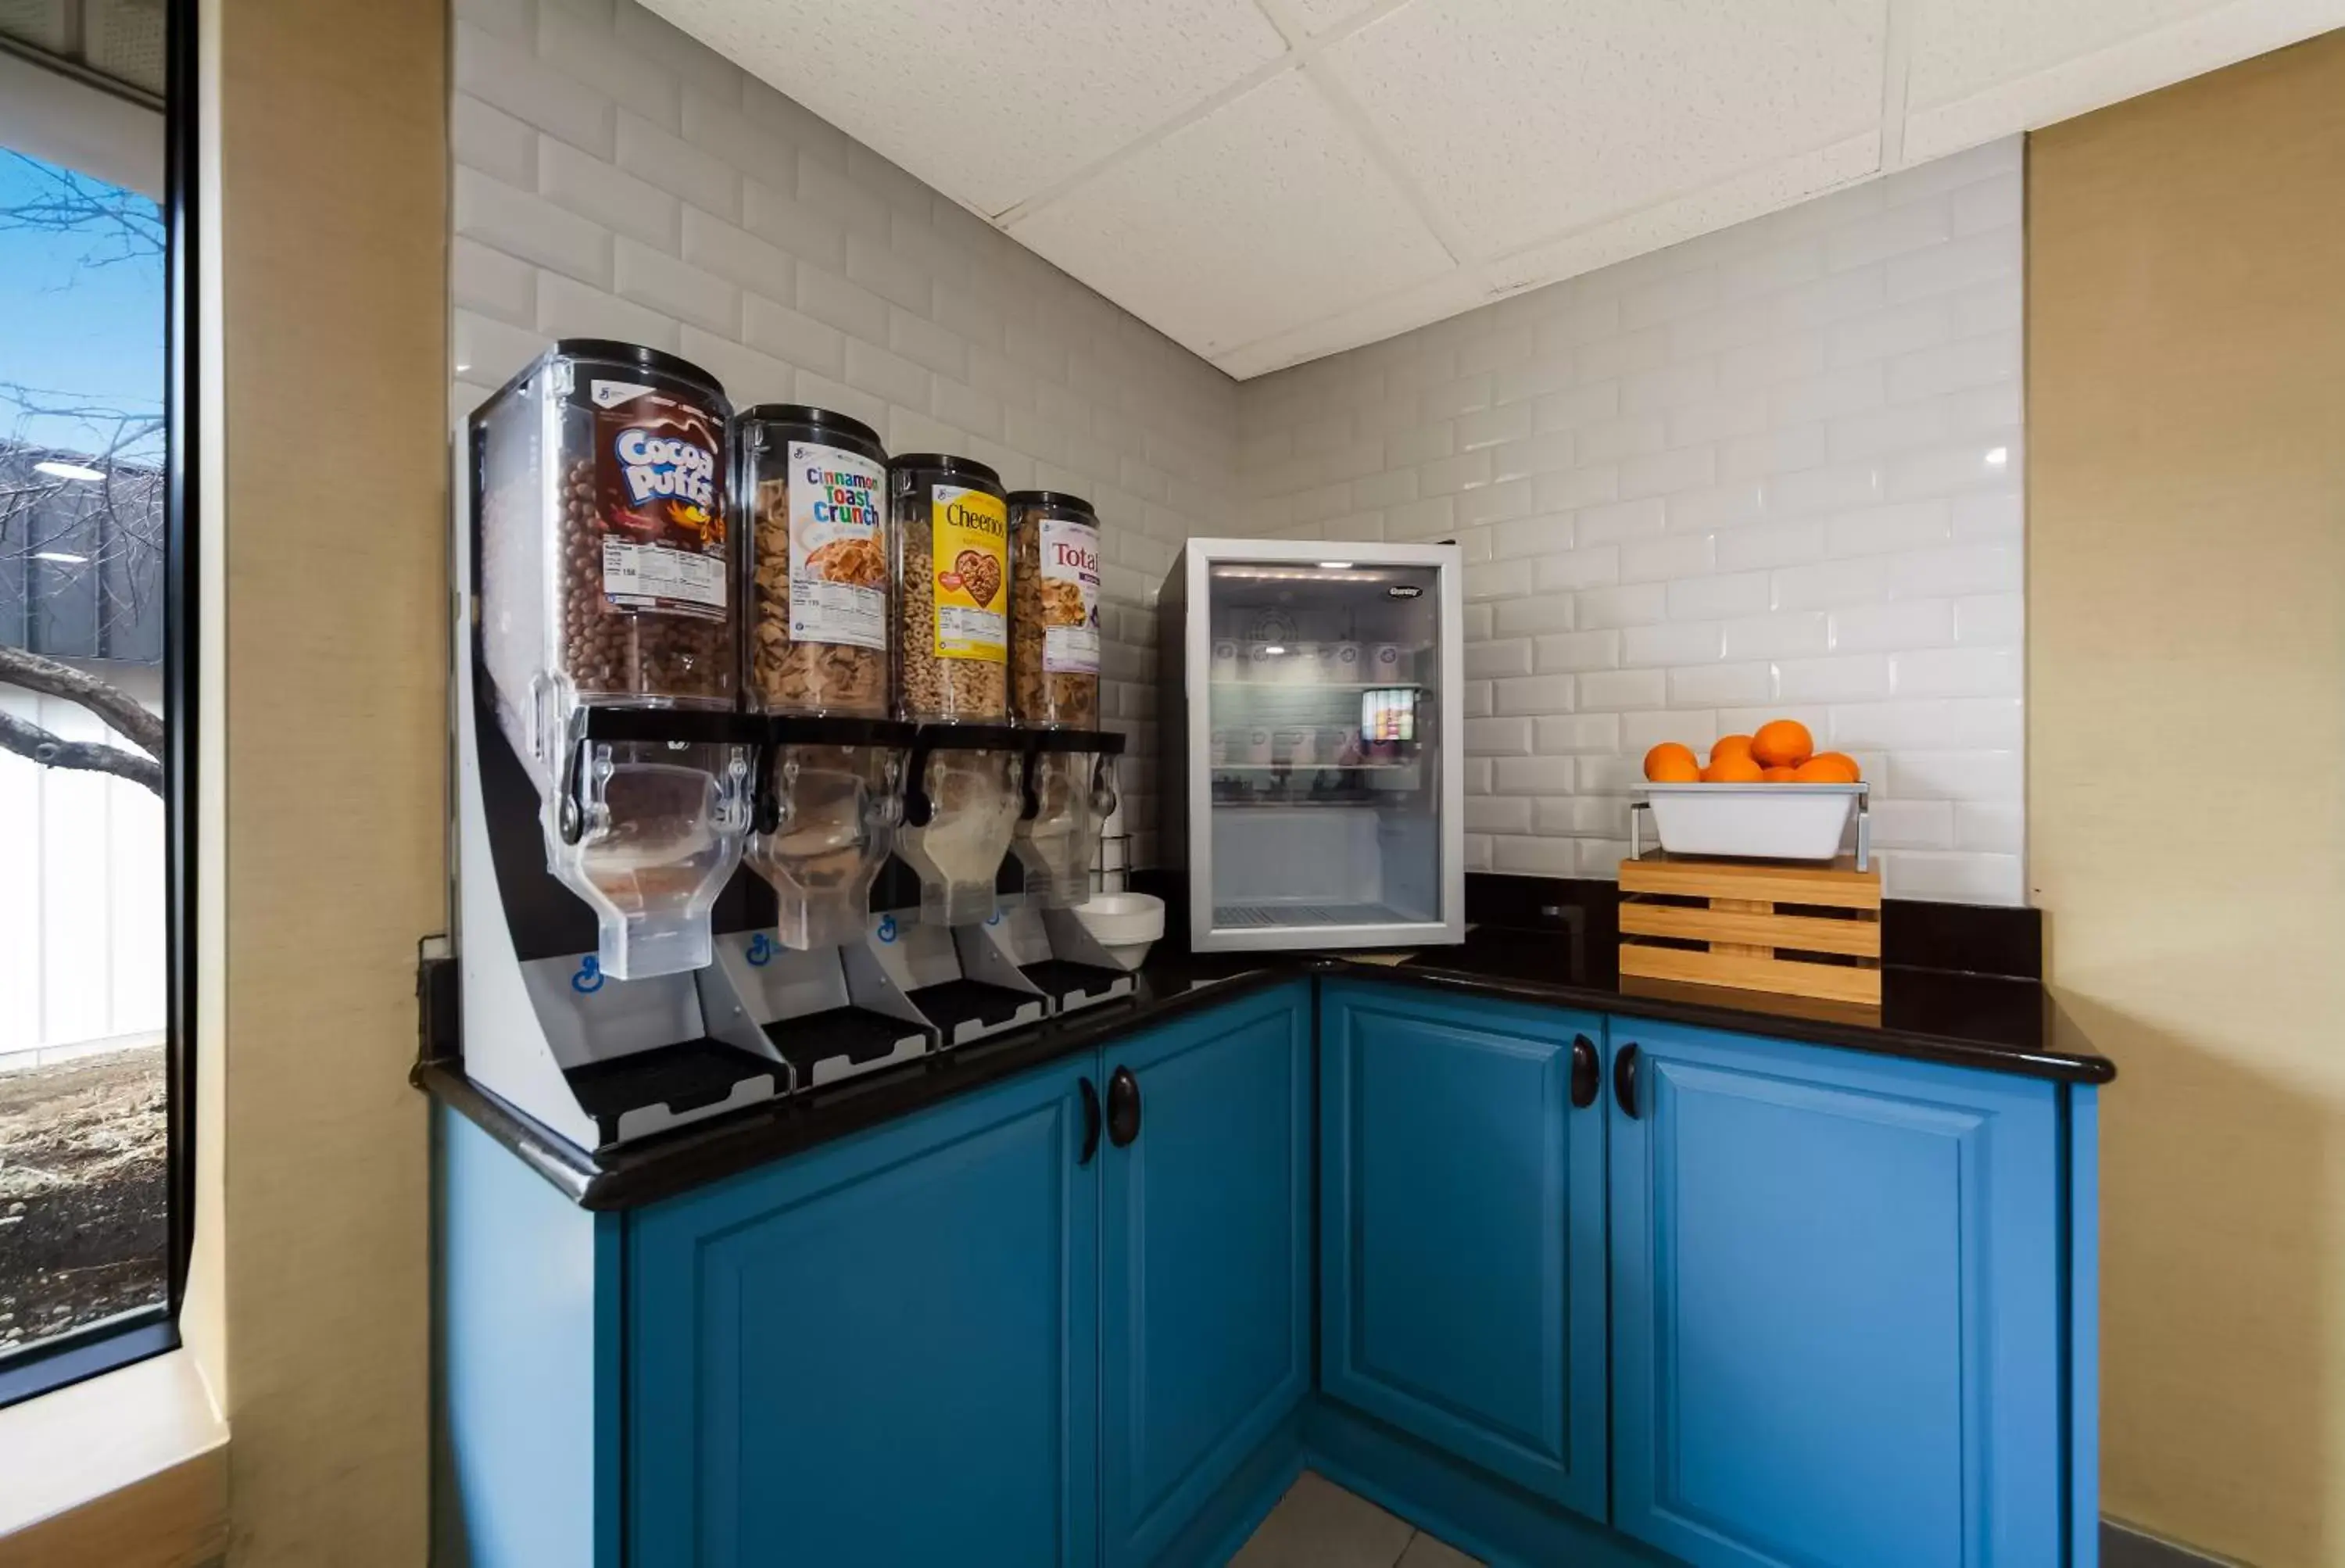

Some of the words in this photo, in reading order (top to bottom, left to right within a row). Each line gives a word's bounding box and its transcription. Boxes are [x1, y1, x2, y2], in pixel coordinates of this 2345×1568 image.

[618, 429, 714, 476] Cocoa
[625, 465, 713, 506] Puffs
[806, 467, 878, 491] Cinnamon
[825, 485, 870, 508] Toast
[813, 501, 880, 528] Crunch
[1051, 542, 1099, 573] Total
